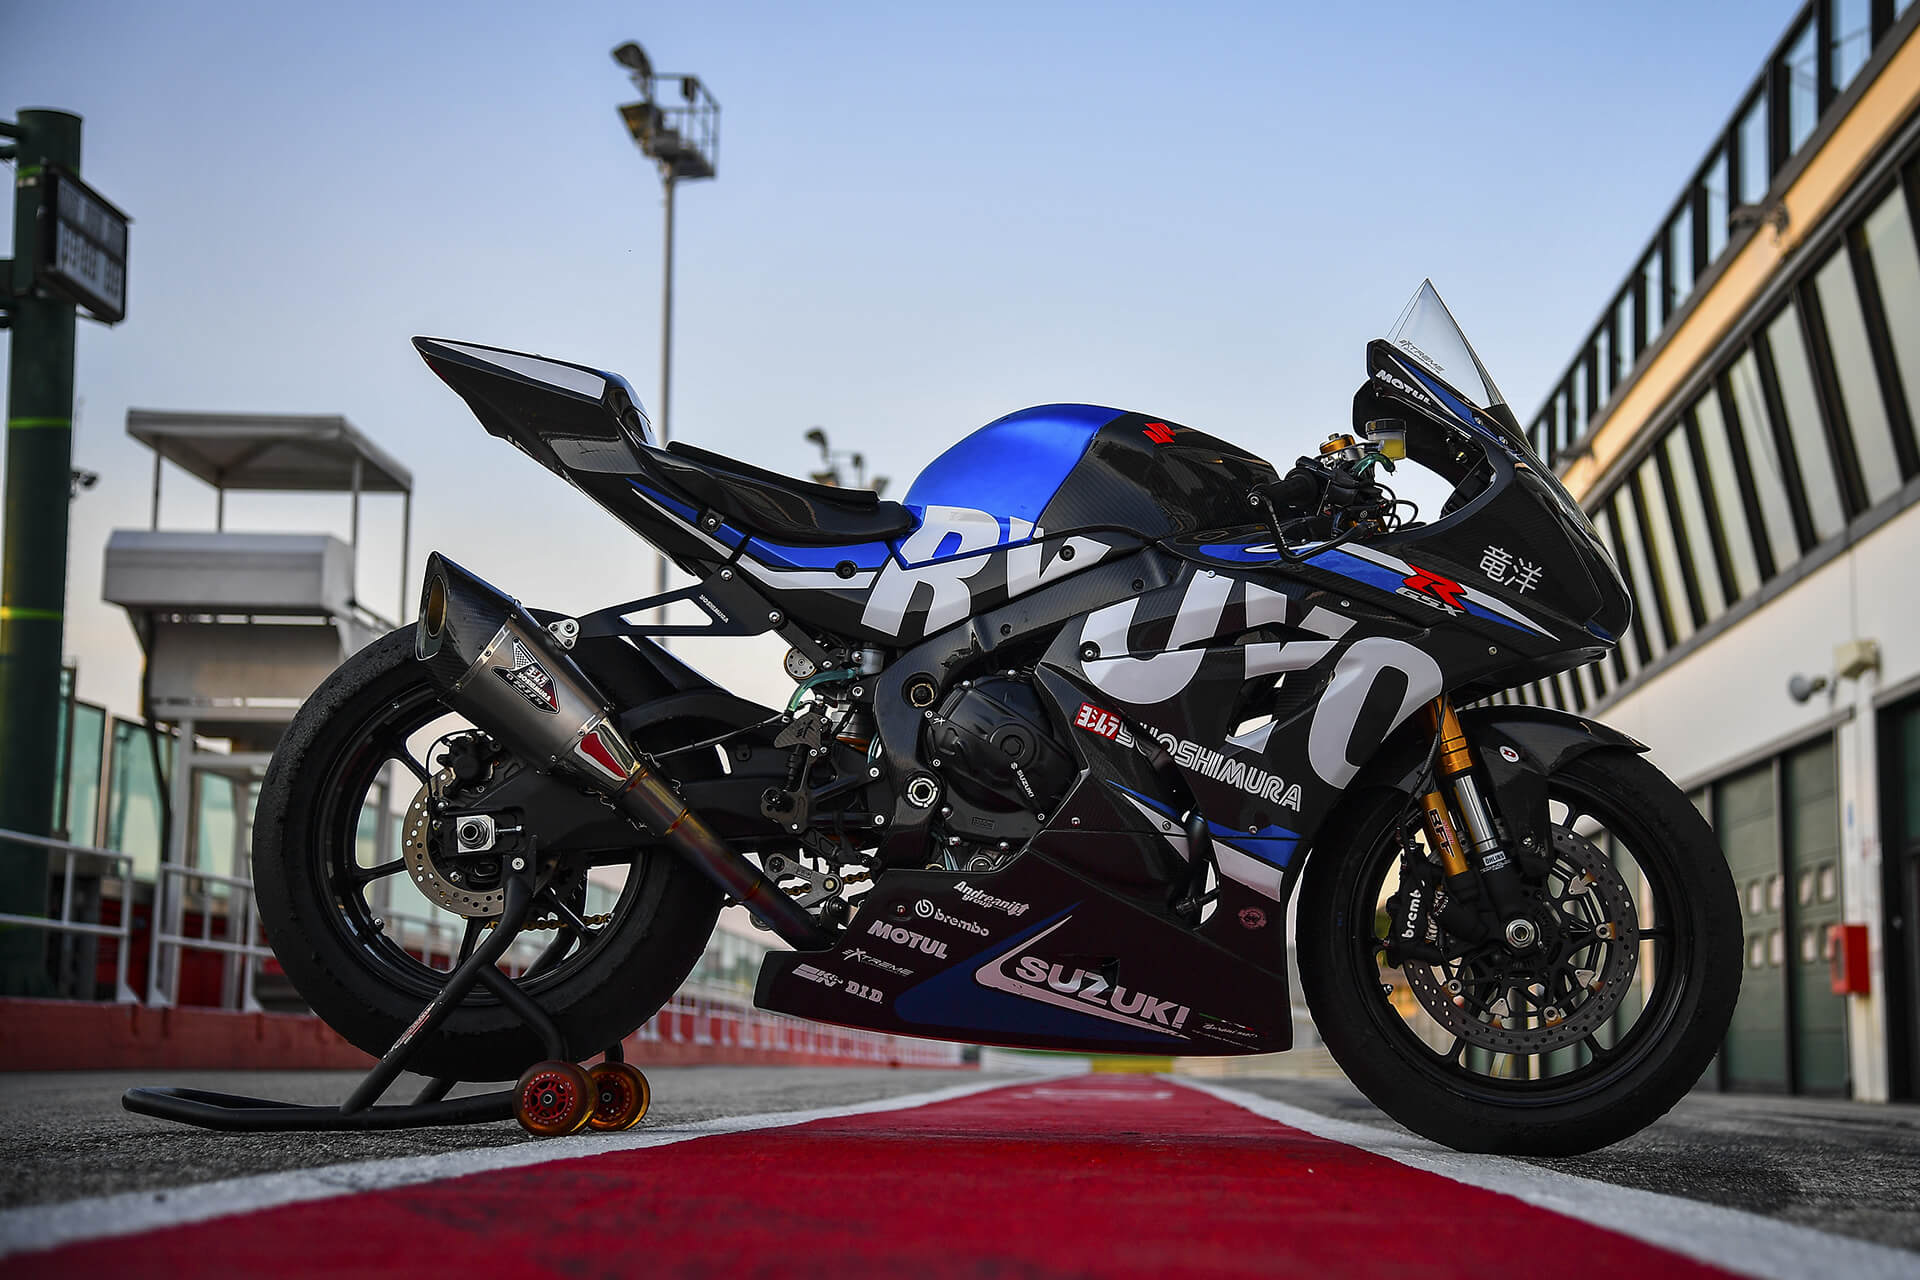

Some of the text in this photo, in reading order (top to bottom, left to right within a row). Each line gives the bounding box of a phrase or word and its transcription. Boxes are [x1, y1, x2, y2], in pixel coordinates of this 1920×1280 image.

[1375, 369, 1432, 405] MOTUL
[1479, 545, 1543, 594] 竜洋
[1015, 769, 1036, 799] SUZUKI
[867, 919, 948, 960] MOTUL
[934, 908, 991, 937] brembo
[1015, 956, 1190, 1029] SUZUKI
